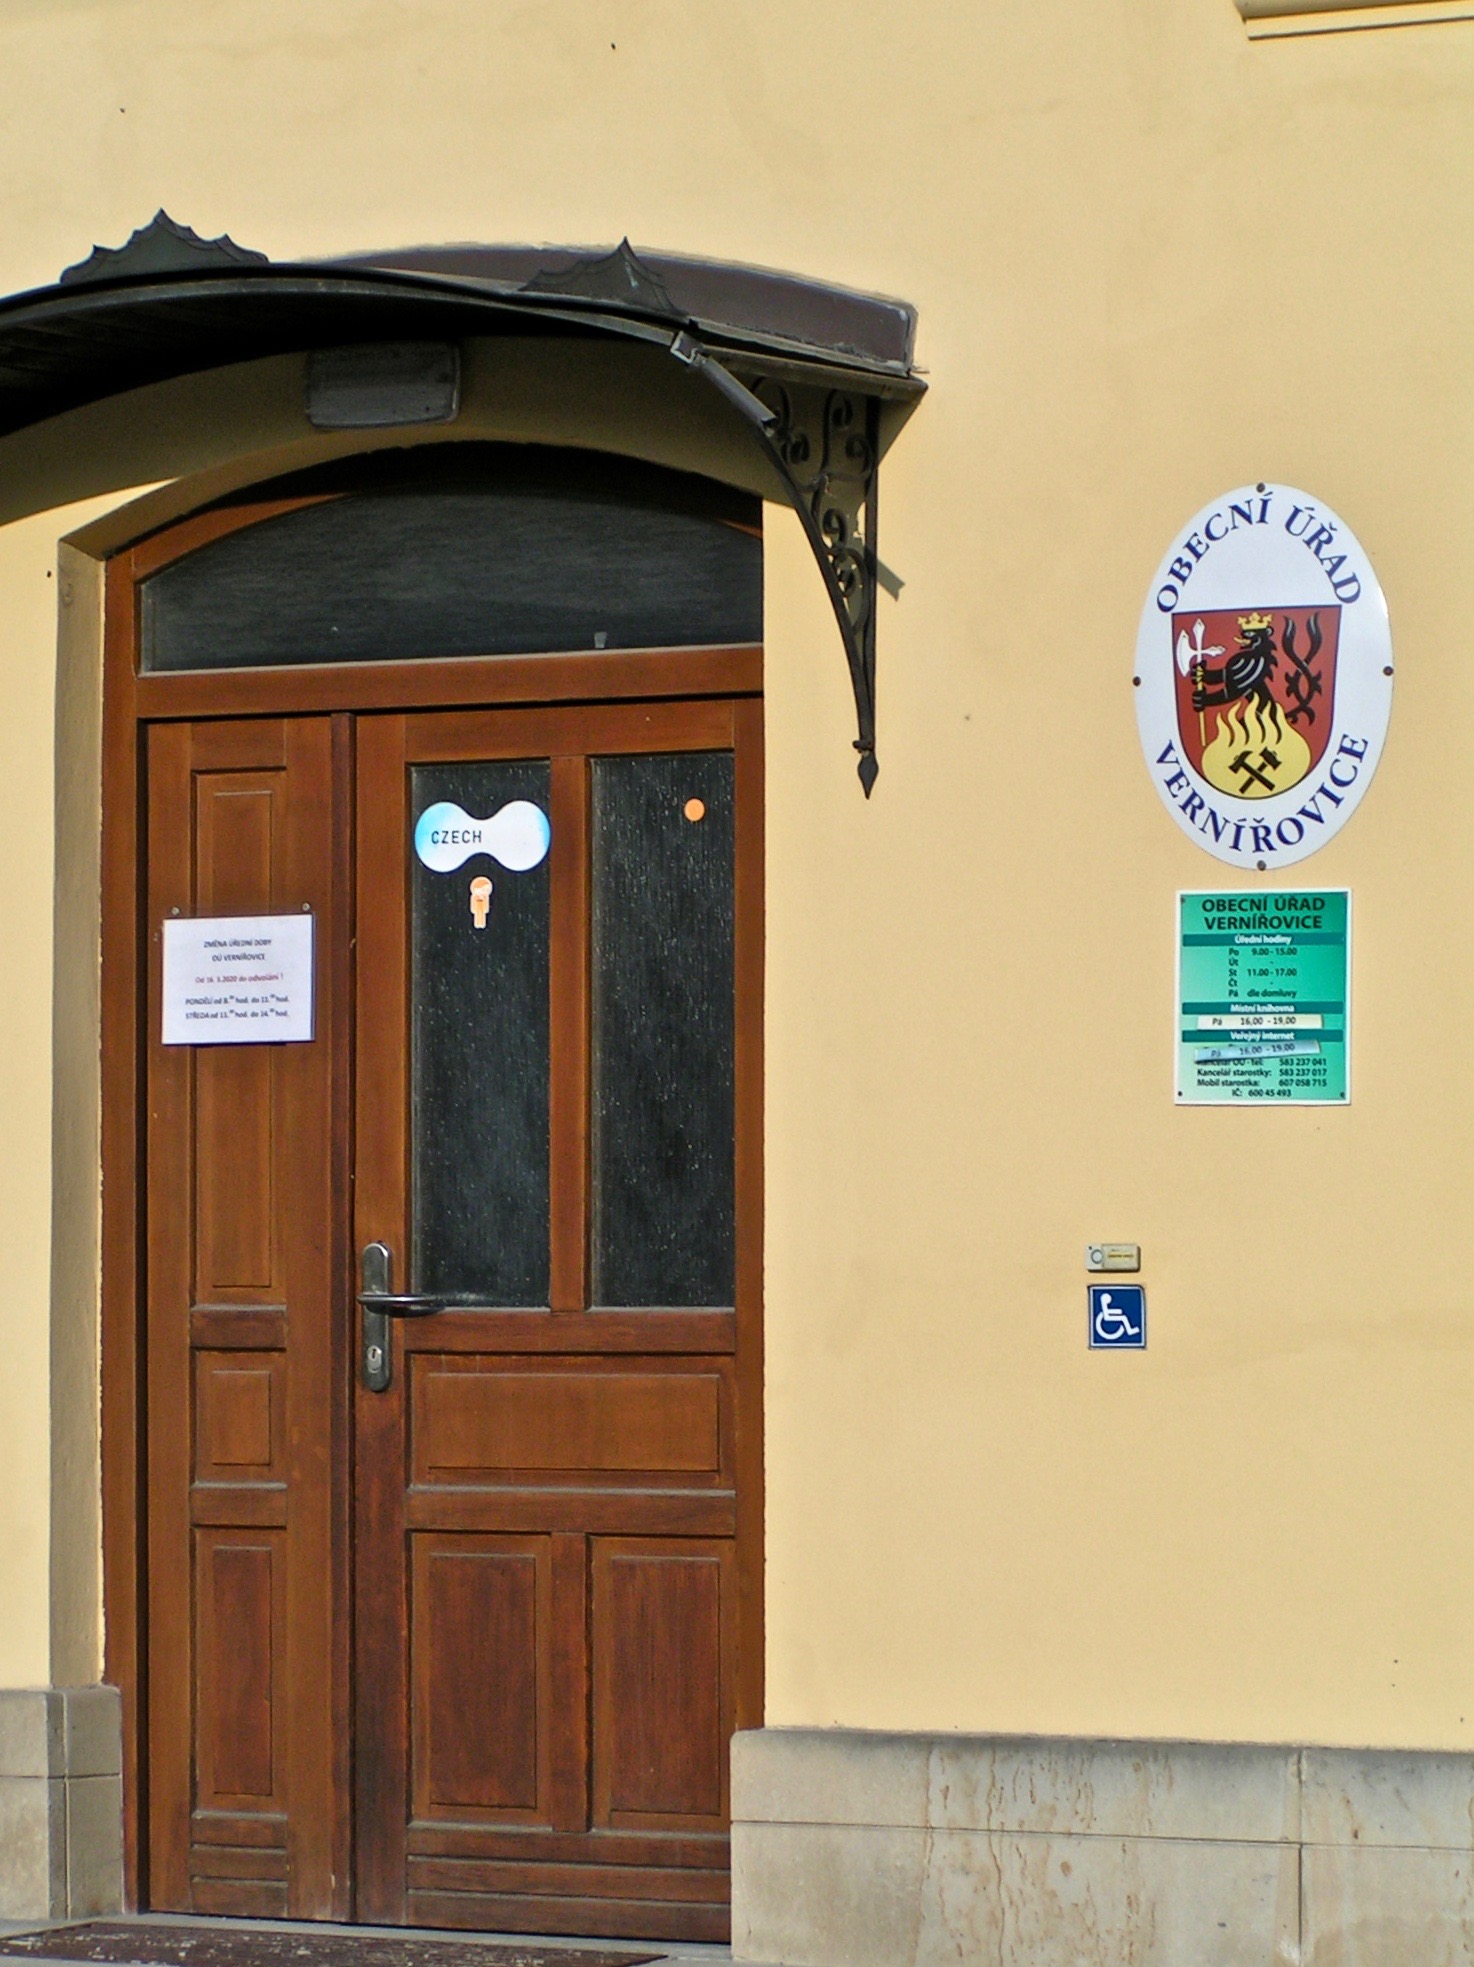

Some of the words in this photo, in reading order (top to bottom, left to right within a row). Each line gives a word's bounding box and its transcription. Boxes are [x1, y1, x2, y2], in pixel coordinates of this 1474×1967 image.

[1156, 492, 1273, 614] OBECNÍ
[1284, 503, 1362, 605] ÚŘAD
[1155, 732, 1369, 853] VERNÍŘOVICE
[430, 830, 483, 845] CZECH
[1202, 896, 1268, 912] OBECNÍ
[1274, 895, 1325, 912] ÚŘAD
[1204, 913, 1323, 930] VERNÍŘOVICE
[1234, 934, 1262, 944] Úřední
[1263, 934, 1292, 945] hodiny
[1228, 948, 1239, 956] Po
[1251, 948, 1269, 956] 9.00
[1228, 957, 1238, 966] Út
[1228, 968, 1237, 976] St
[1247, 968, 1269, 976] 11.00
[1228, 988, 1239, 998] Pá
[1261, 988, 1298, 999] domluvy
[1230, 1004, 1256, 1012] Místní
[1258, 1004, 1295, 1012] knihovna
[1212, 1017, 1222, 1026] Pá
[1230, 1031, 1261, 1042] Veřejný
[1262, 1031, 1295, 1040] internet
[1197, 1068, 1232, 1076] Kancelář
[1232, 1068, 1272, 1078] starostky:
[1197, 1078, 1220, 1086] Mobil
[1248, 1088, 1264, 1097] 600
[1265, 1088, 1276, 1097] 45
[1277, 1088, 1292, 1097] 493
